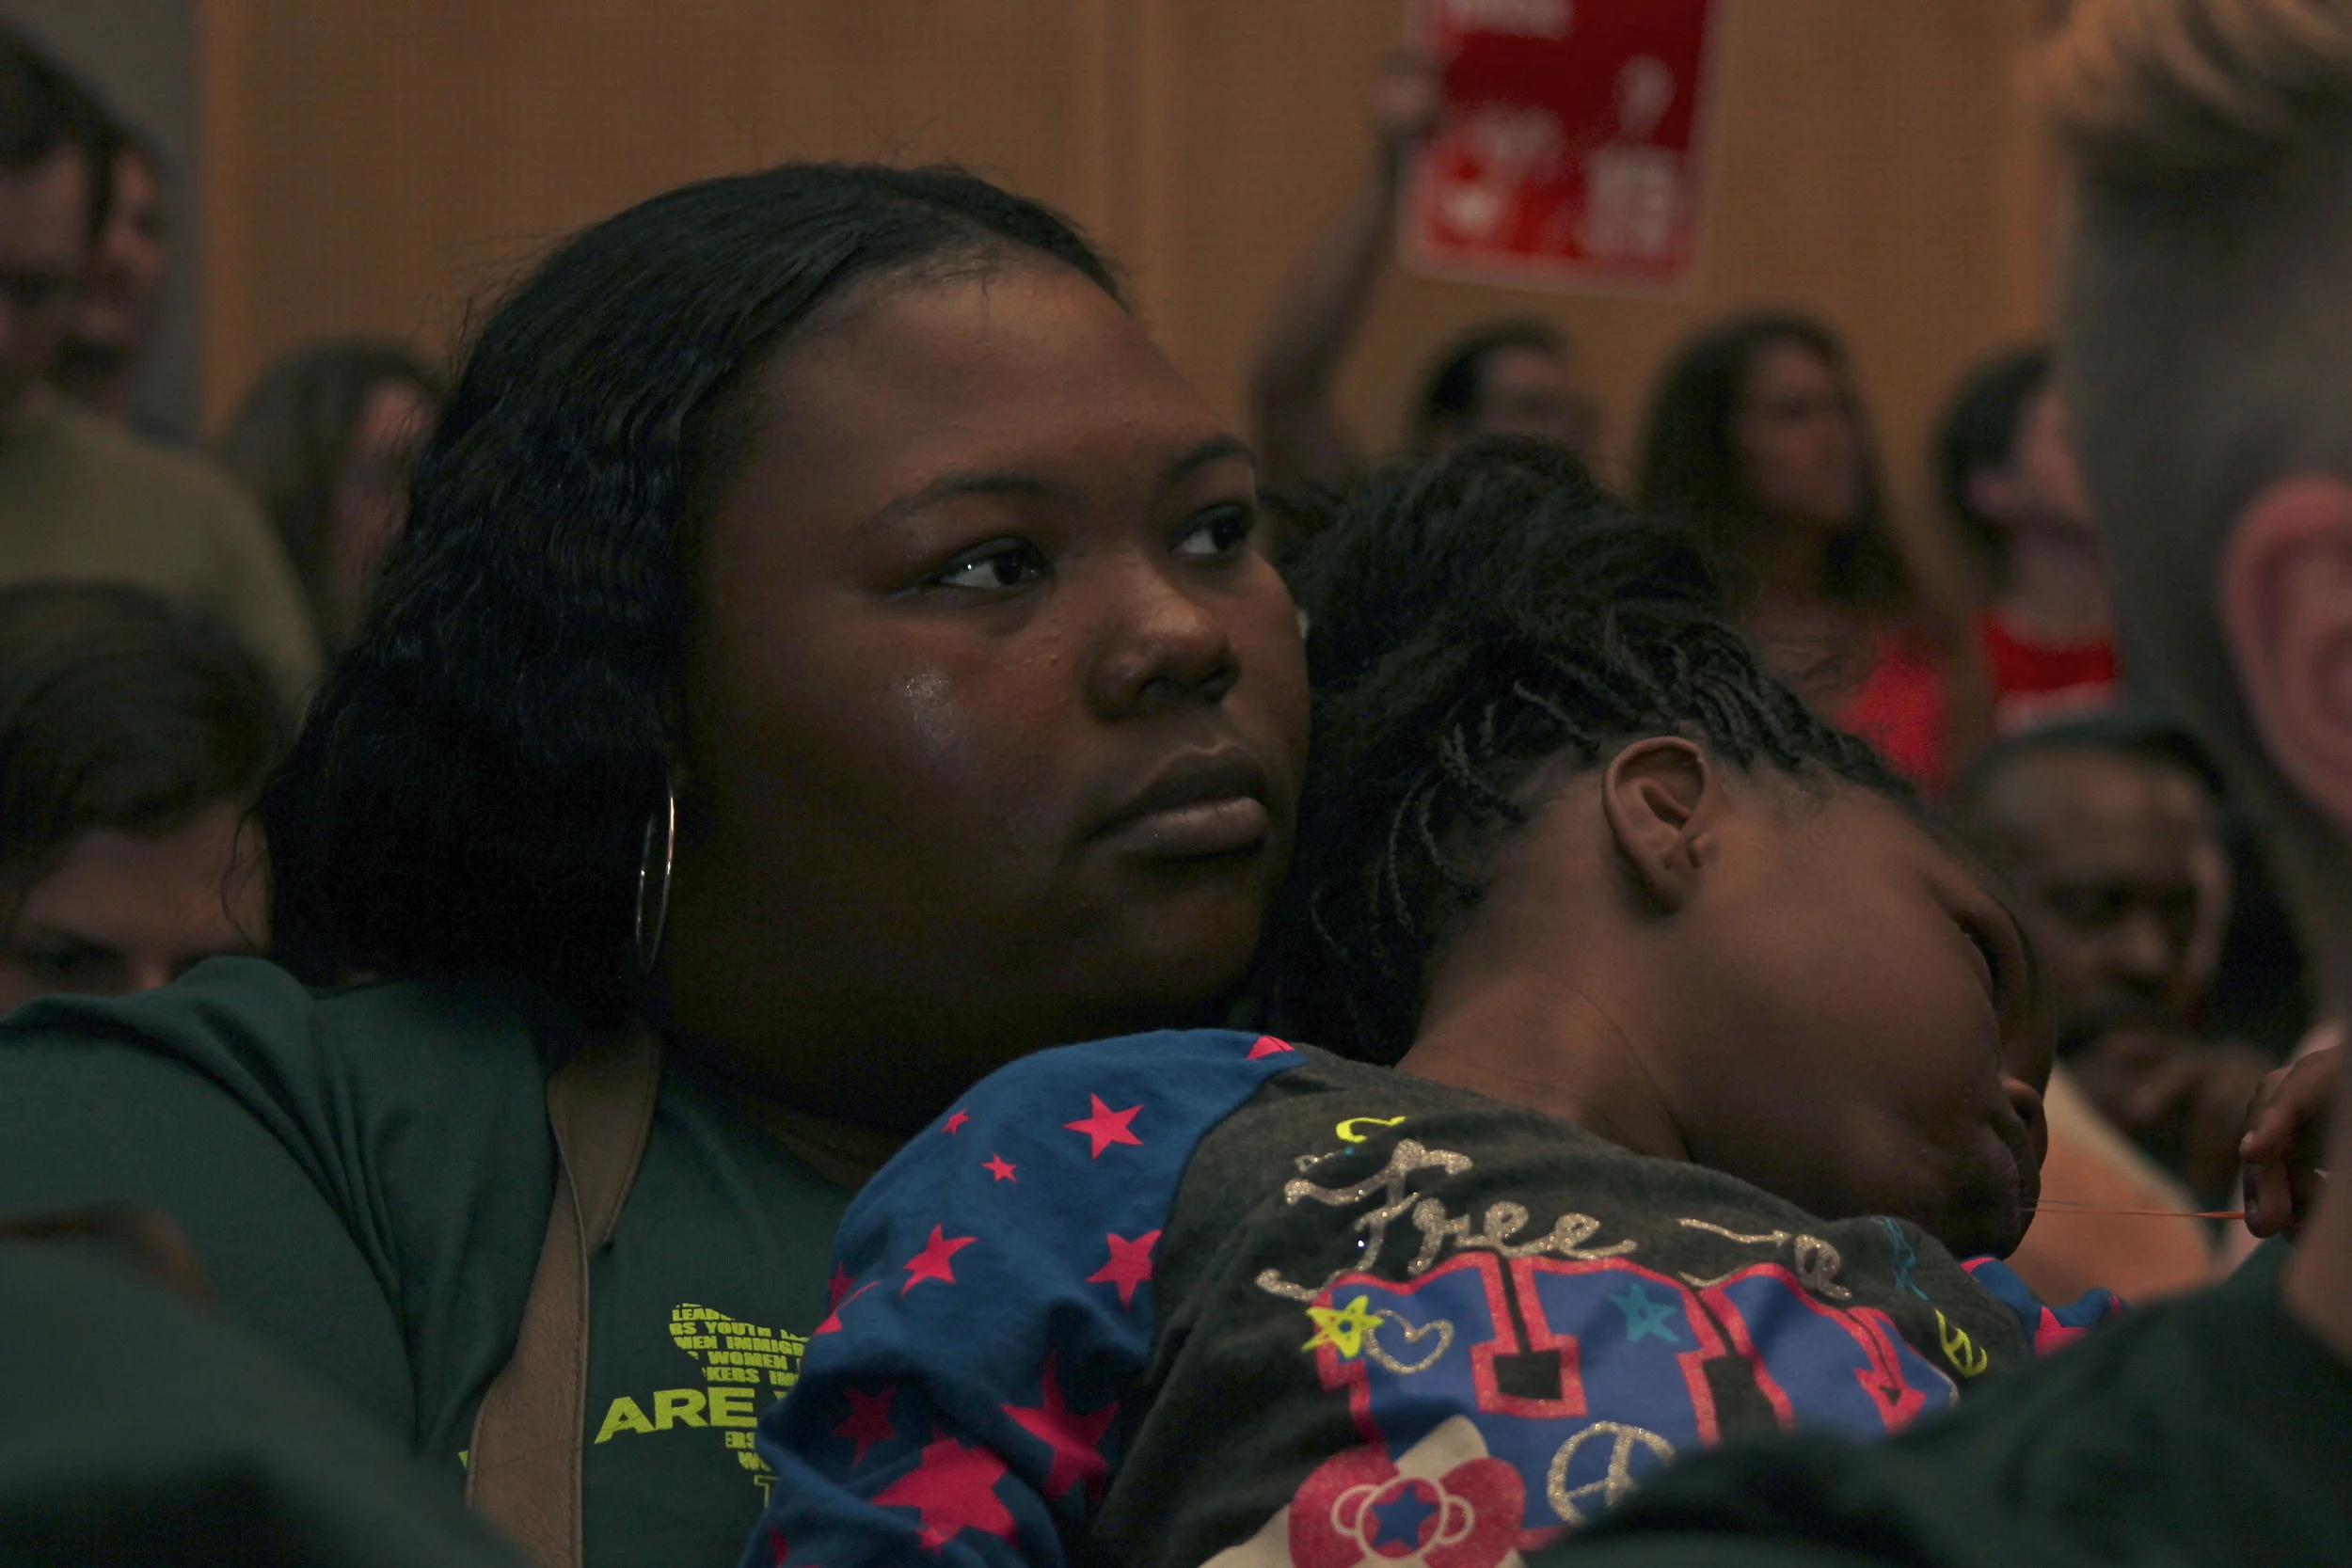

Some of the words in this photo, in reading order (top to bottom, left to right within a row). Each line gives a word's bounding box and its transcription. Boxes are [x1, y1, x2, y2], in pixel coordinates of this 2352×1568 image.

[1254, 1138, 1639, 1303] Free
[707, 1351, 788, 1370] WOMEN
[594, 1386, 758, 1446] ARE
